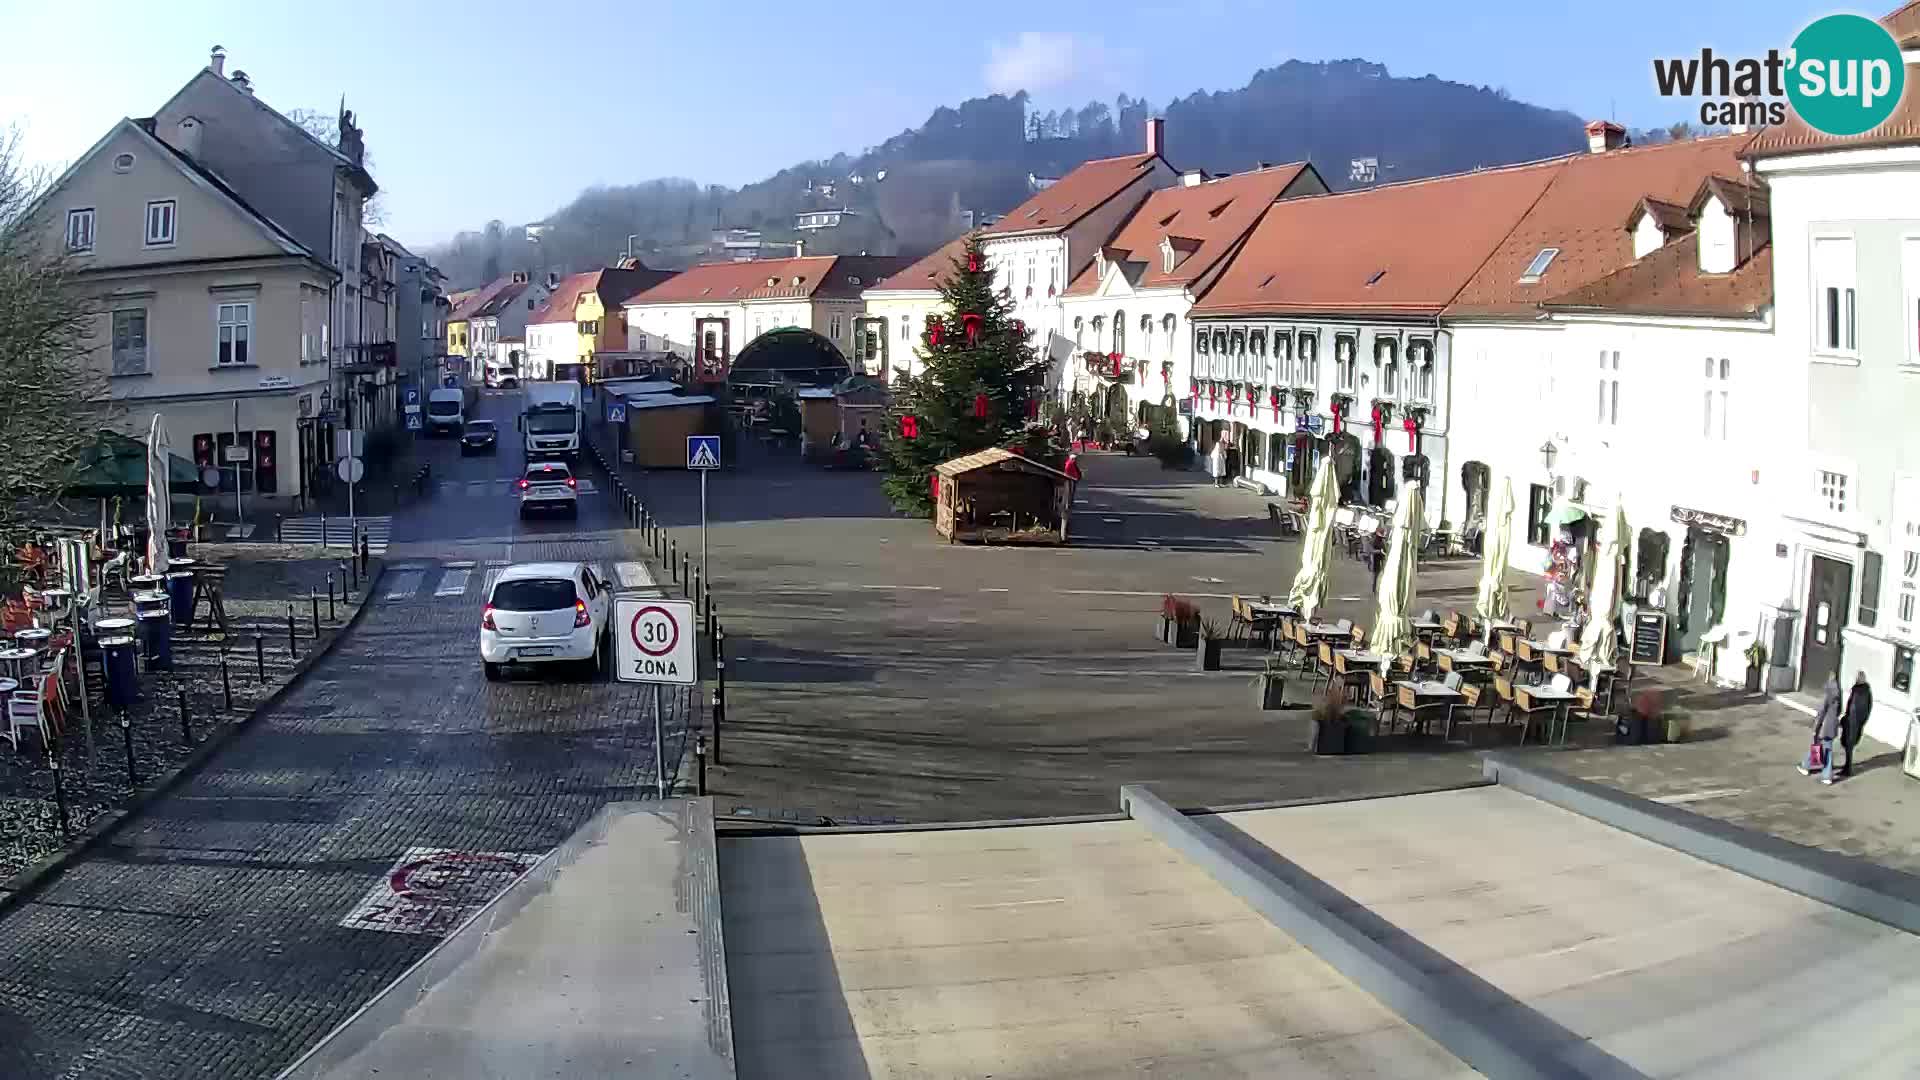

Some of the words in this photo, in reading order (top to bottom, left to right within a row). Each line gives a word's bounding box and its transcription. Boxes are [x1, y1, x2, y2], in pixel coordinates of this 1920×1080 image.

[408, 391, 416, 402] P
[643, 621, 668, 643] 30
[633, 659, 678, 676] ZONA
